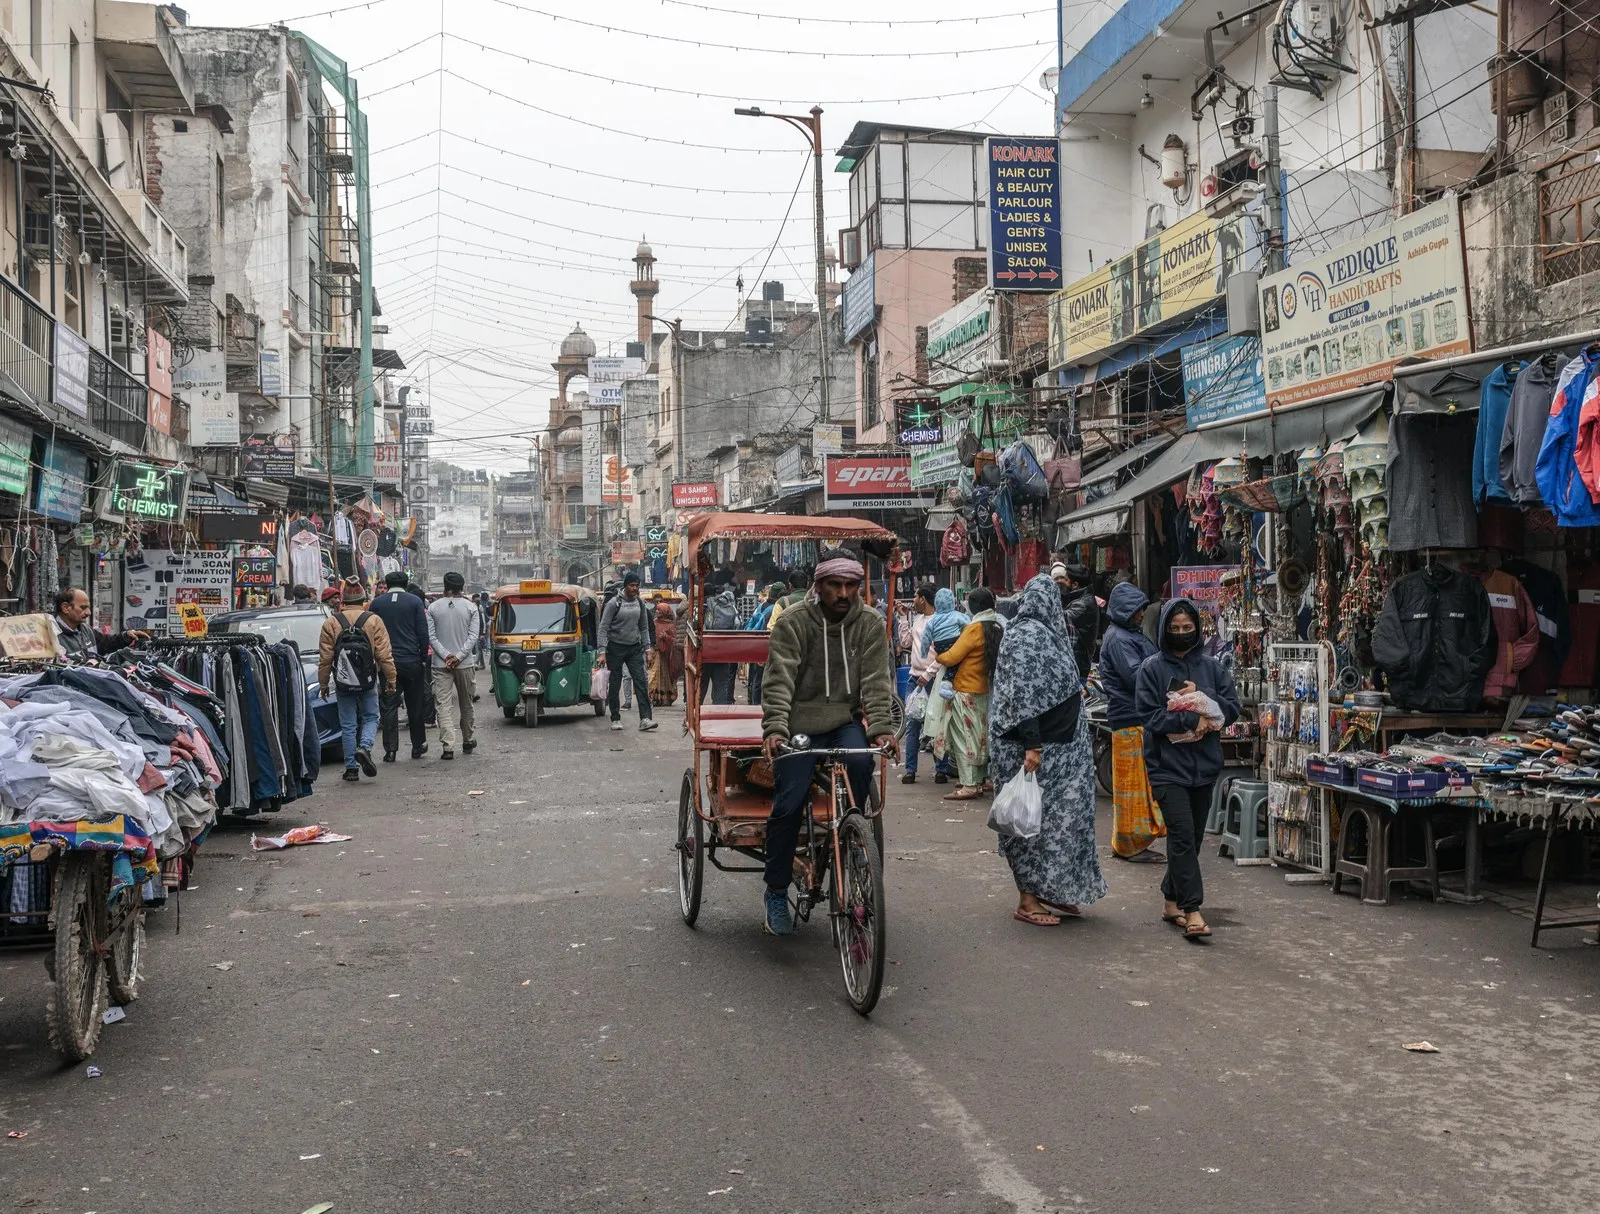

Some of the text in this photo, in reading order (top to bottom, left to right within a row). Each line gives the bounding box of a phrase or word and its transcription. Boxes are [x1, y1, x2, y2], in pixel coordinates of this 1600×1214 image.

[992, 146, 1056, 162] KONARK
[998, 168, 1051, 178] HAIR CUT
[996, 183, 1053, 192] & BEAUTY
[998, 198, 1052, 208] PARLOUR
[1000, 212, 1052, 222] LADIES &
[1007, 228, 1045, 237] GENTS
[1006, 242, 1047, 252] UNISEX
[1164, 228, 1210, 274] KONARK
[1408, 238, 1449, 260] Ashish Gupta
[1008, 258, 1046, 267] SALON
[1326, 236, 1398, 284] VEDIQUE
[1328, 269, 1402, 309] HANDICRAFTS
[1444, 284, 1457, 295] Items
[1070, 284, 1108, 323] KONARK
[946, 311, 990, 352] PHARMACY
[408, 408, 428, 418] HOTEL
[902, 430, 939, 441] CHEMIST
[262, 522, 276, 535] NI
[252, 563, 268, 571] ICE
[243, 575, 273, 583] CREAM
[185, 609, 199, 618] SALE
[7, 622, 37, 635] SALE
